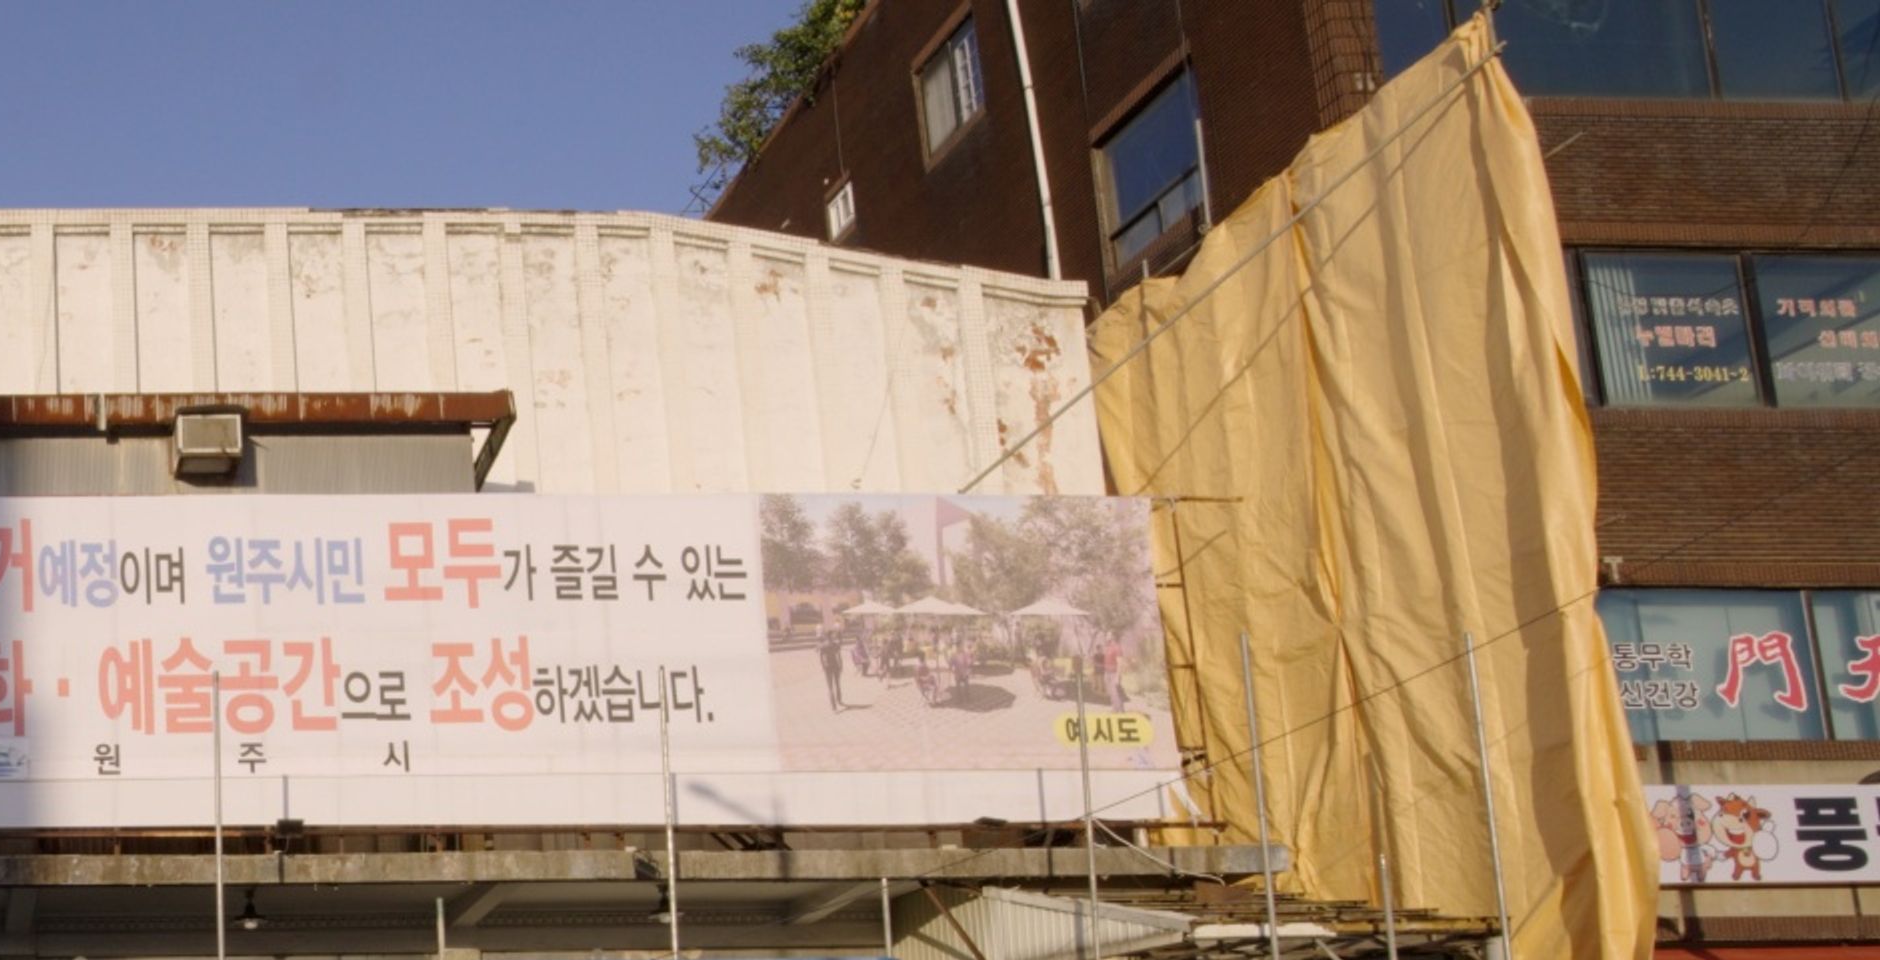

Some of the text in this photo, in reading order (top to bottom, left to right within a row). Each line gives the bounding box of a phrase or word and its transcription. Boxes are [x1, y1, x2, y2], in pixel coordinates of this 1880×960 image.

[206, 535, 366, 605] 원주시민
[384, 518, 536, 609] 모두가
[550, 542, 618, 601] 즐길
[632, 543, 667, 601] 수
[680, 543, 748, 602] 있는
[98, 636, 411, 735] 예술공간으로
[429, 636, 715, 731] 조성하겠습니다.
[94, 740, 410, 774] 원 주 시
[1065, 717, 1141, 744] 예시도
[1793, 795, 1880, 872] 풍
